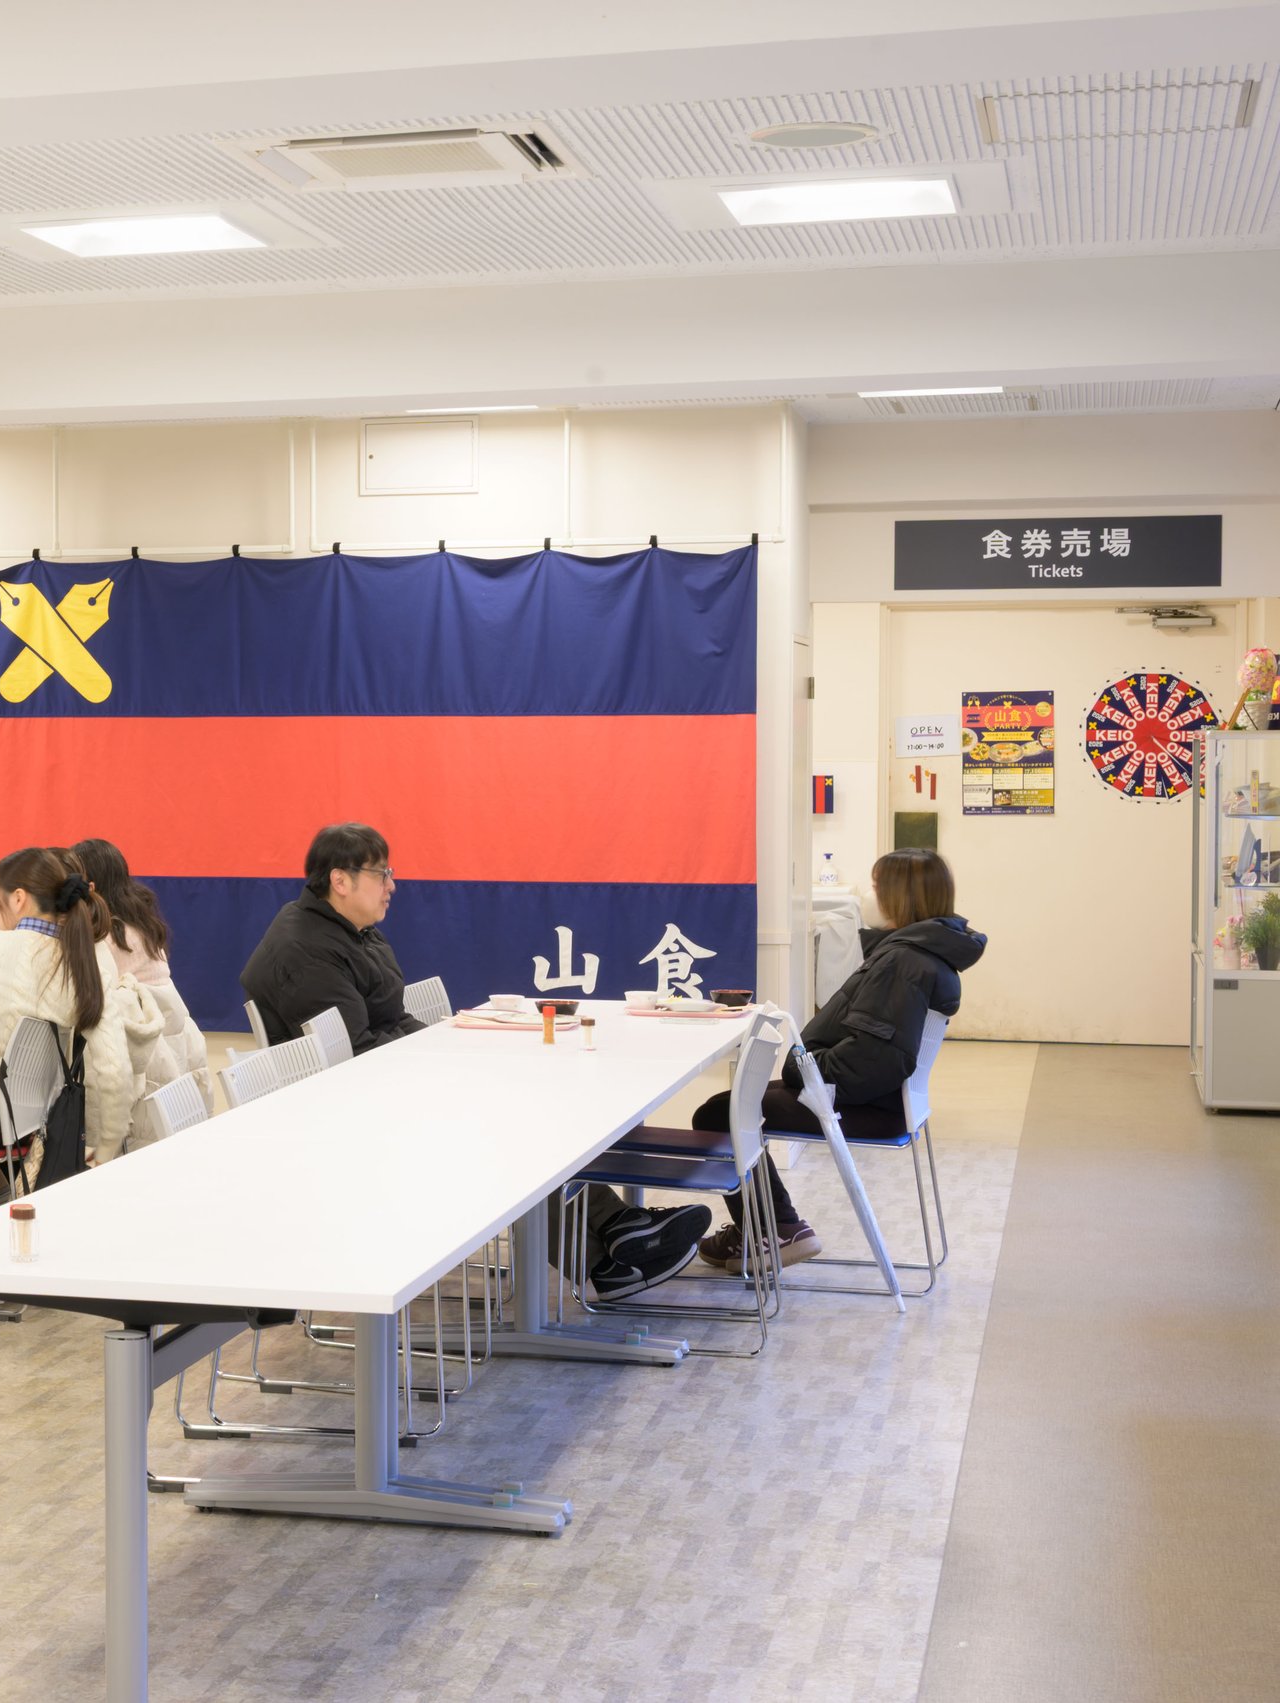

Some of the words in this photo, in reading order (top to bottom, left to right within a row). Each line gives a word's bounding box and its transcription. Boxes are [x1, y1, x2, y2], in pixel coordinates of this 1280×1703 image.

[982, 528, 1132, 559] 食券売場
[1028, 564, 1083, 578] Tickets
[1120, 687, 1146, 721] KEIO
[1146, 682, 1159, 719] KEIO
[1158, 688, 1186, 722] KEIO
[994, 710, 1022, 722] 山食
[994, 722, 1022, 731] PARTY
[1101, 705, 1137, 730] KEIO
[1166, 705, 1204, 730] KEIO
[910, 726, 943, 735] OPEN
[1095, 730, 1134, 741] KEIO
[1169, 730, 1194, 742] EIO
[1101, 741, 1137, 765] KEIO
[1166, 742, 1193, 765] EIO
[1117, 750, 1145, 783] KEIO
[1144, 752, 1157, 789] KEIO
[1157, 752, 1184, 786] KEIO
[532, 923, 718, 1001] 山食
